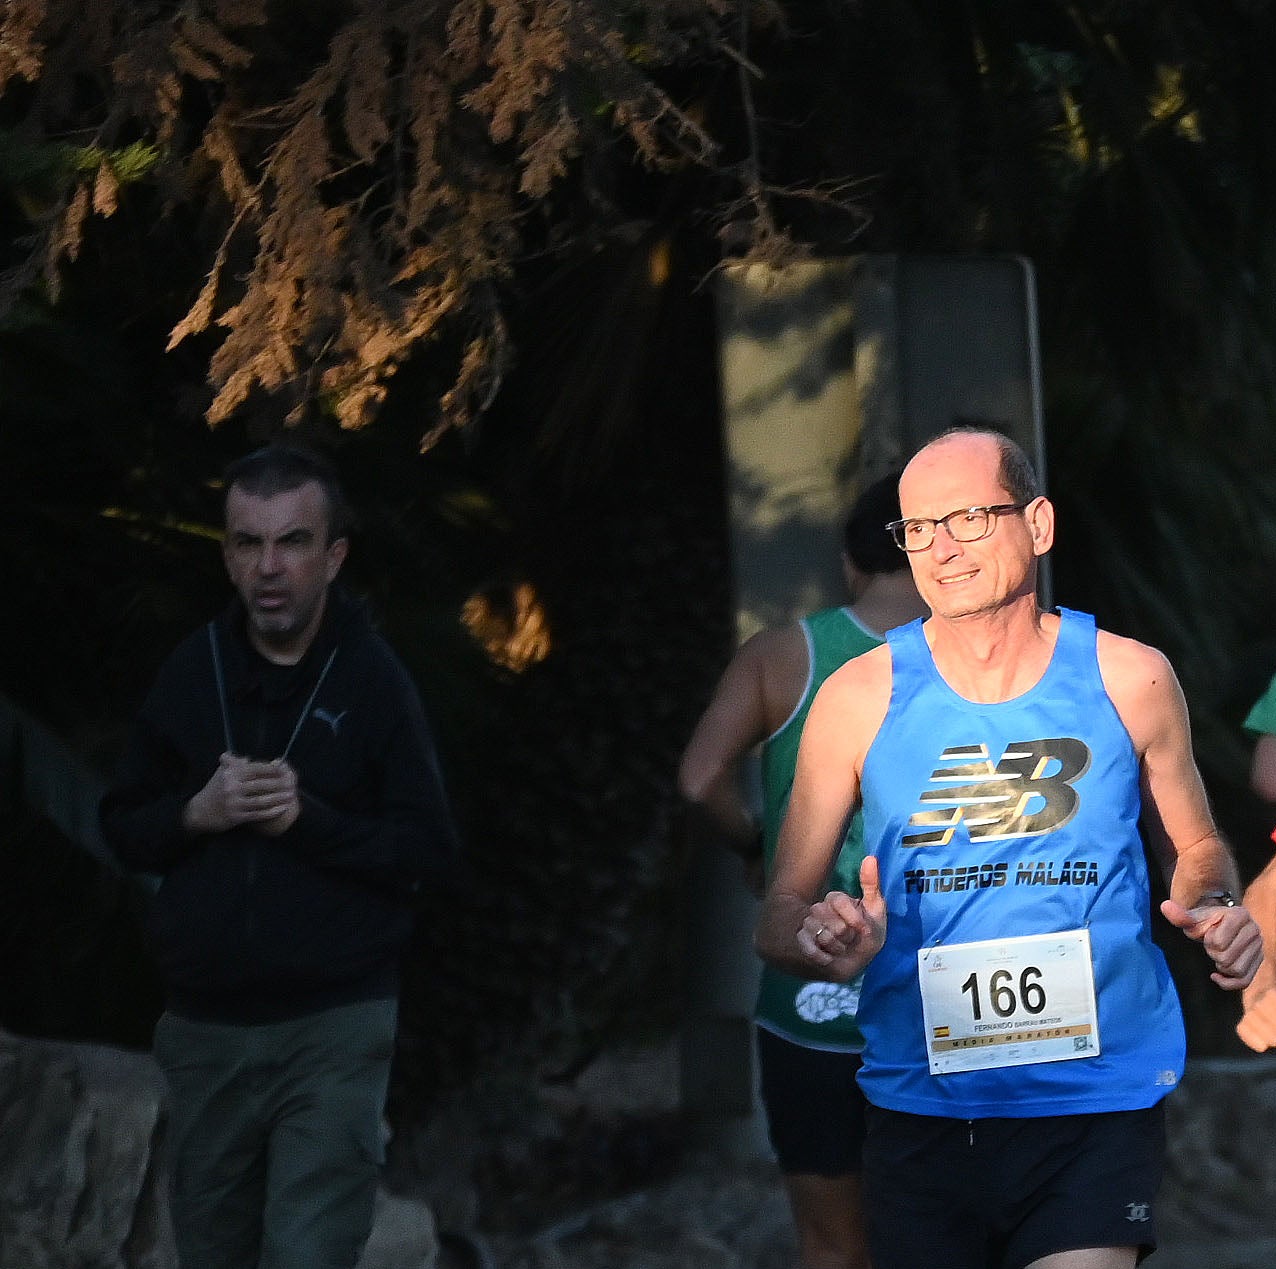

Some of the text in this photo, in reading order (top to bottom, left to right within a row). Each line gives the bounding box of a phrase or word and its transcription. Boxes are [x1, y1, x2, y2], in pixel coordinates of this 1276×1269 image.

[904, 861, 1099, 895] FONDEROS MALAGA
[961, 966, 1047, 1021] 166
[974, 1021, 1013, 1032] FERNANDO
